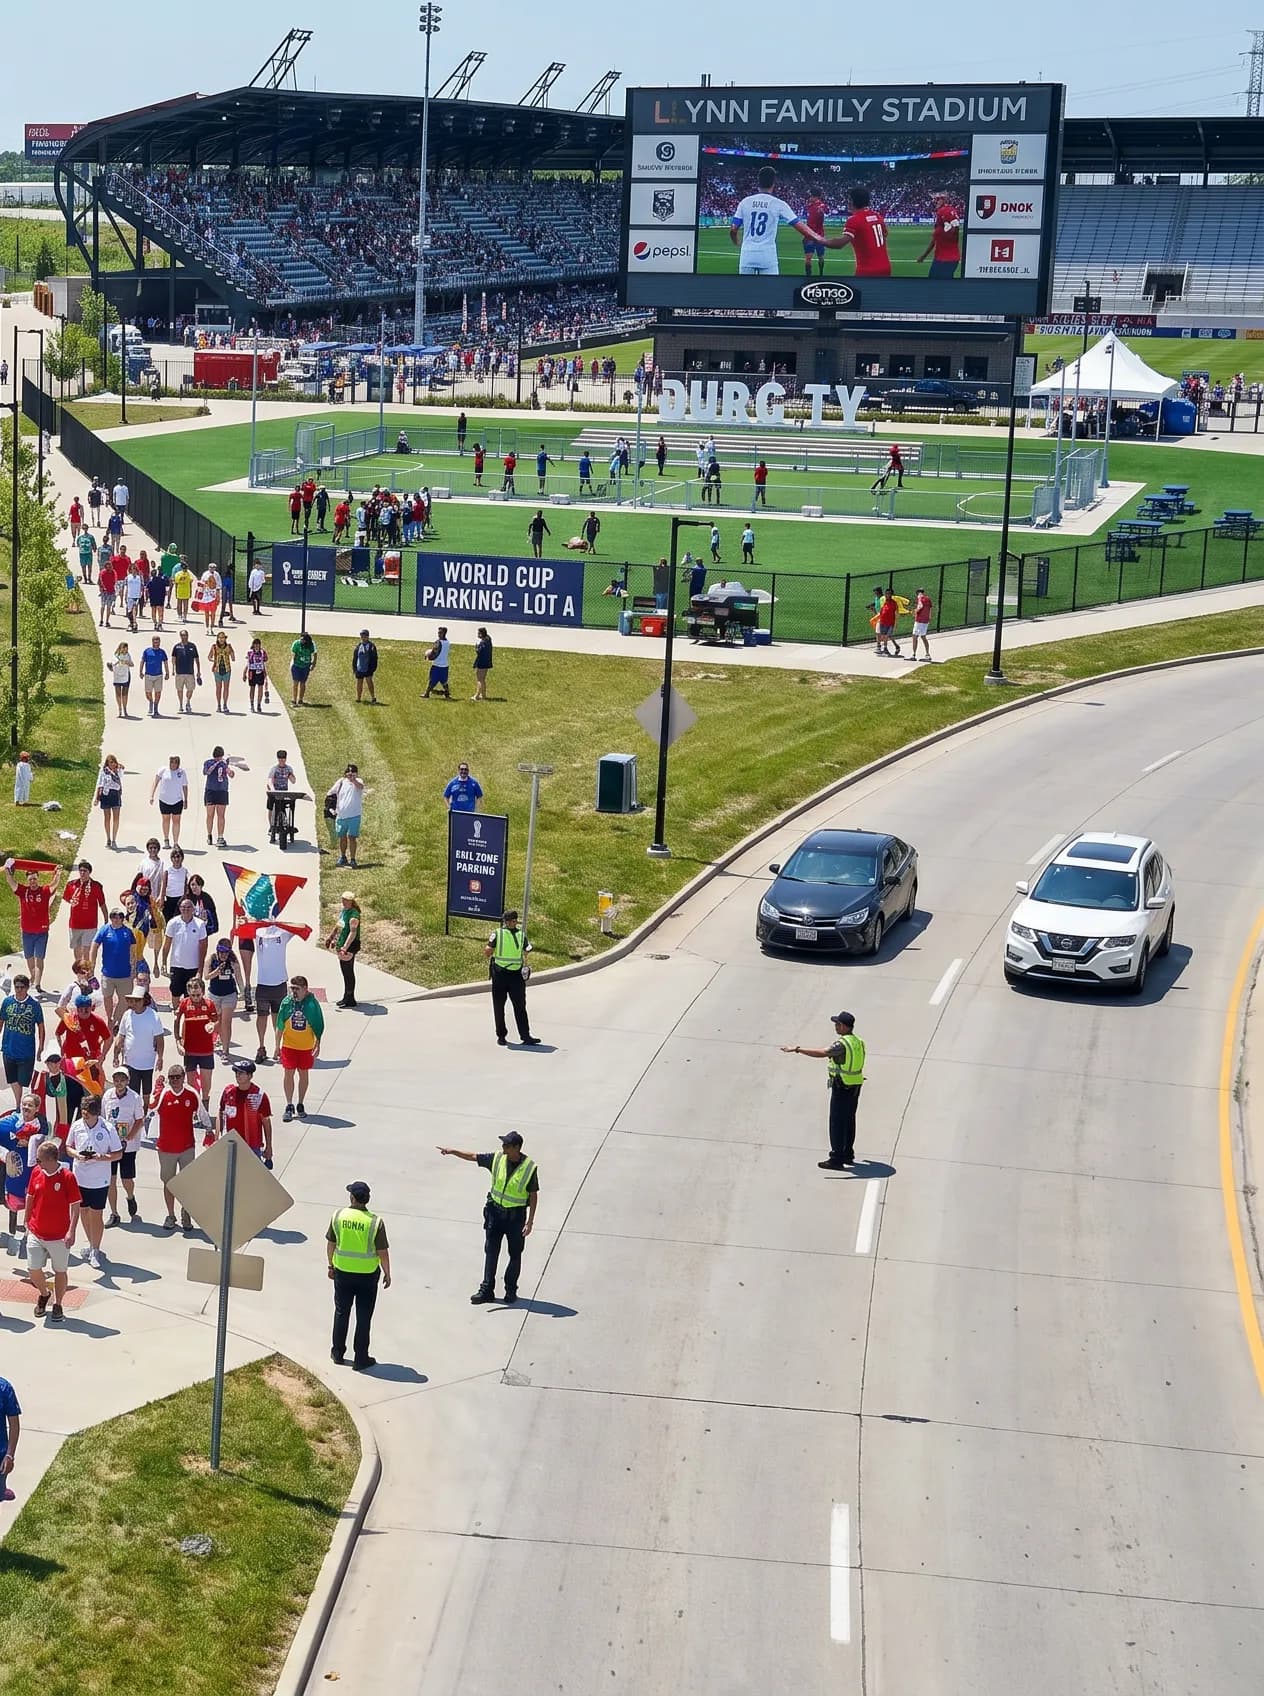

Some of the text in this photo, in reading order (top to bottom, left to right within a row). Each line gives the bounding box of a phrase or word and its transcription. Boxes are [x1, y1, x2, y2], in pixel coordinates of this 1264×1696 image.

[760, 98, 872, 123] FAMILY
[882, 96, 1027, 122] STADIUM
[804, 383, 867, 425] TY
[443, 561, 554, 589] WORLD CUP
[423, 585, 503, 611] PARKING
[524, 593, 559, 616] LOT
[562, 595, 575, 617] A
[475, 852, 499, 864] ZONE
